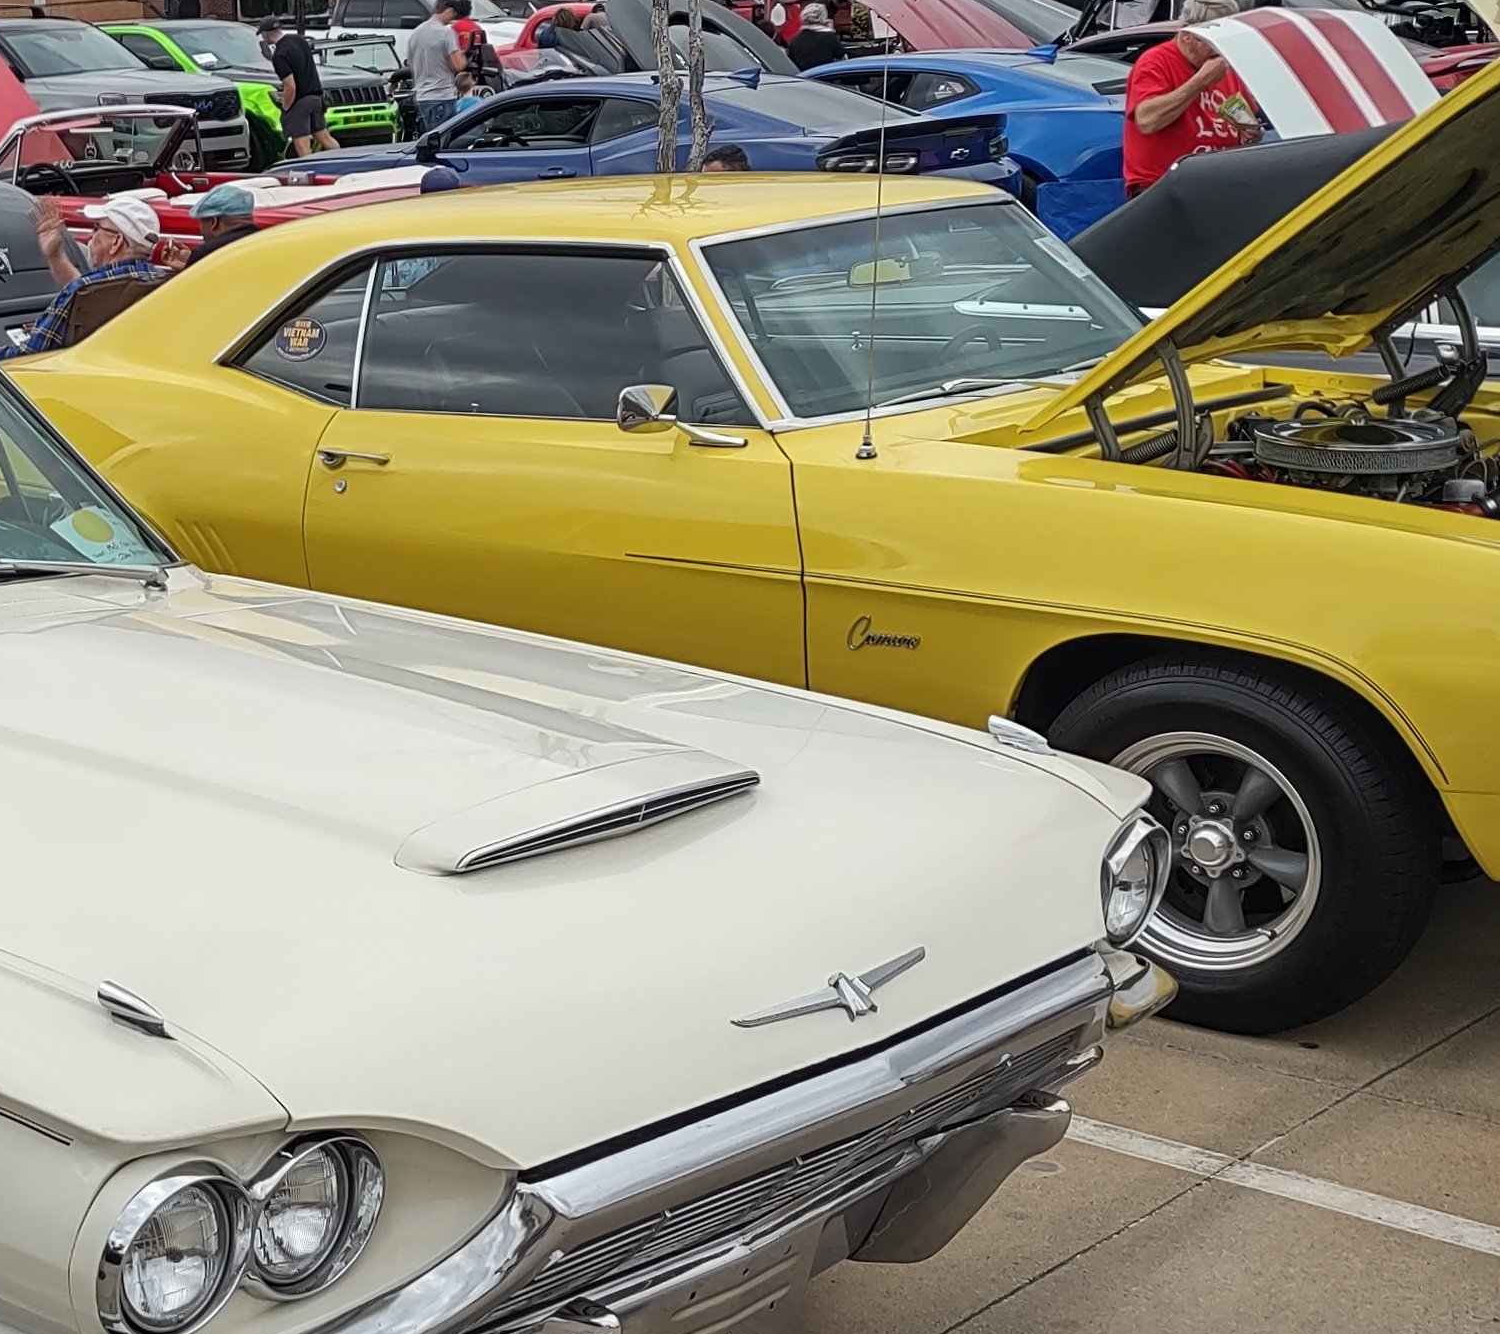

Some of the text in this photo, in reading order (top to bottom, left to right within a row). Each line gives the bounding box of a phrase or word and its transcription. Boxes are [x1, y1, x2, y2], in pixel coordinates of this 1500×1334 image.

[283, 327, 320, 338] VIETNAM
[290, 337, 309, 347] WAR
[846, 614, 922, 651] Camaro
